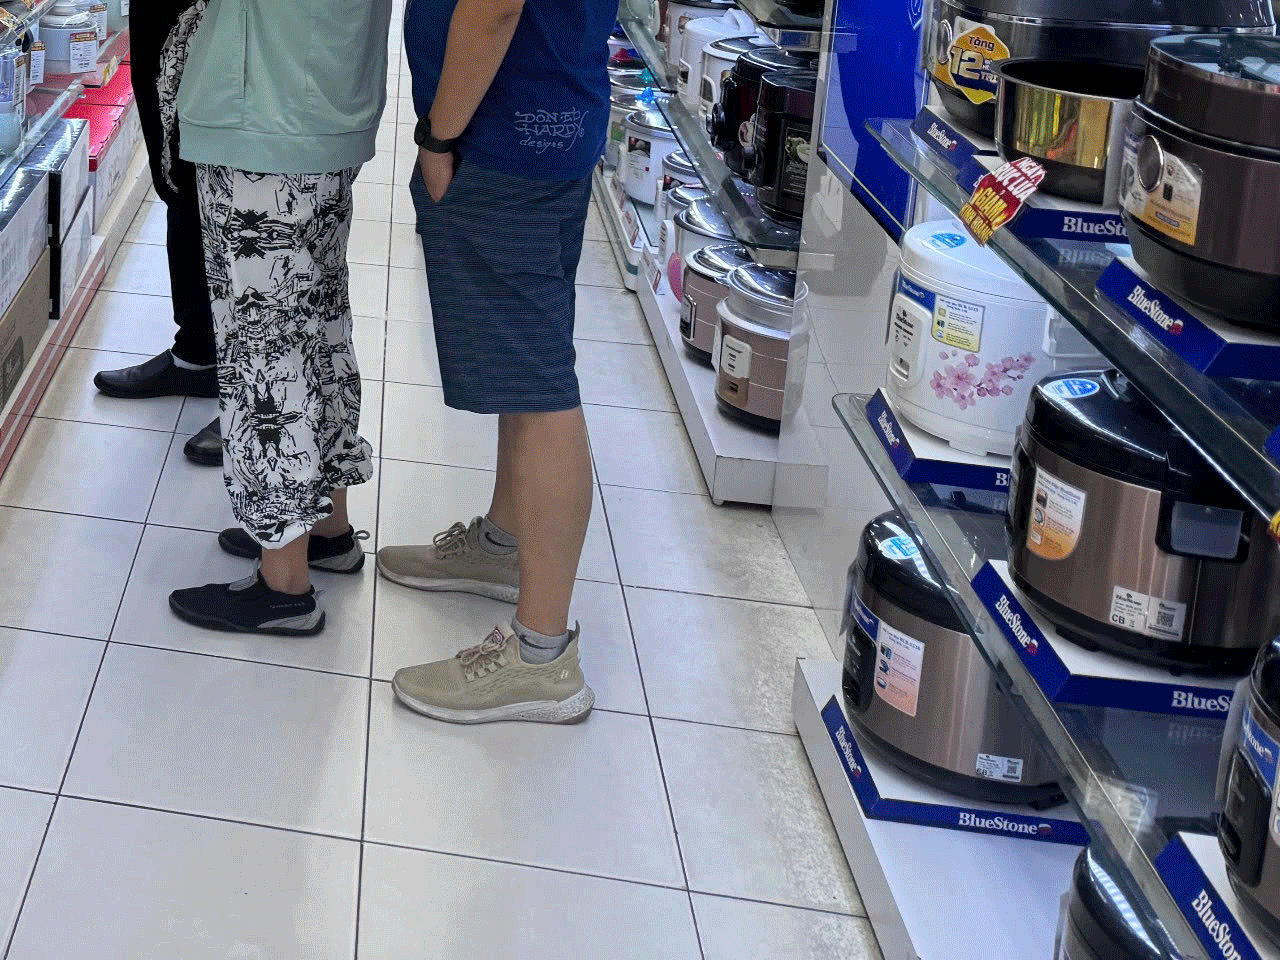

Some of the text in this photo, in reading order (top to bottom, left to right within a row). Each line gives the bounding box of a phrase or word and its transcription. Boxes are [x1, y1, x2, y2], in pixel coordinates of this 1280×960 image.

[968, 35, 995, 52] Tặng
[950, 45, 985, 79] 12
[928, 122, 952, 150] BlueStone
[1062, 216, 1128, 236] BlueSto
[1127, 285, 1174, 331] BlueStone
[878, 411, 897, 446] BlueStone
[994, 594, 1032, 649] BlueStone
[1112, 614, 1126, 625] CB
[835, 726, 858, 774] BlueStone
[958, 813, 1038, 836] BlueStone
